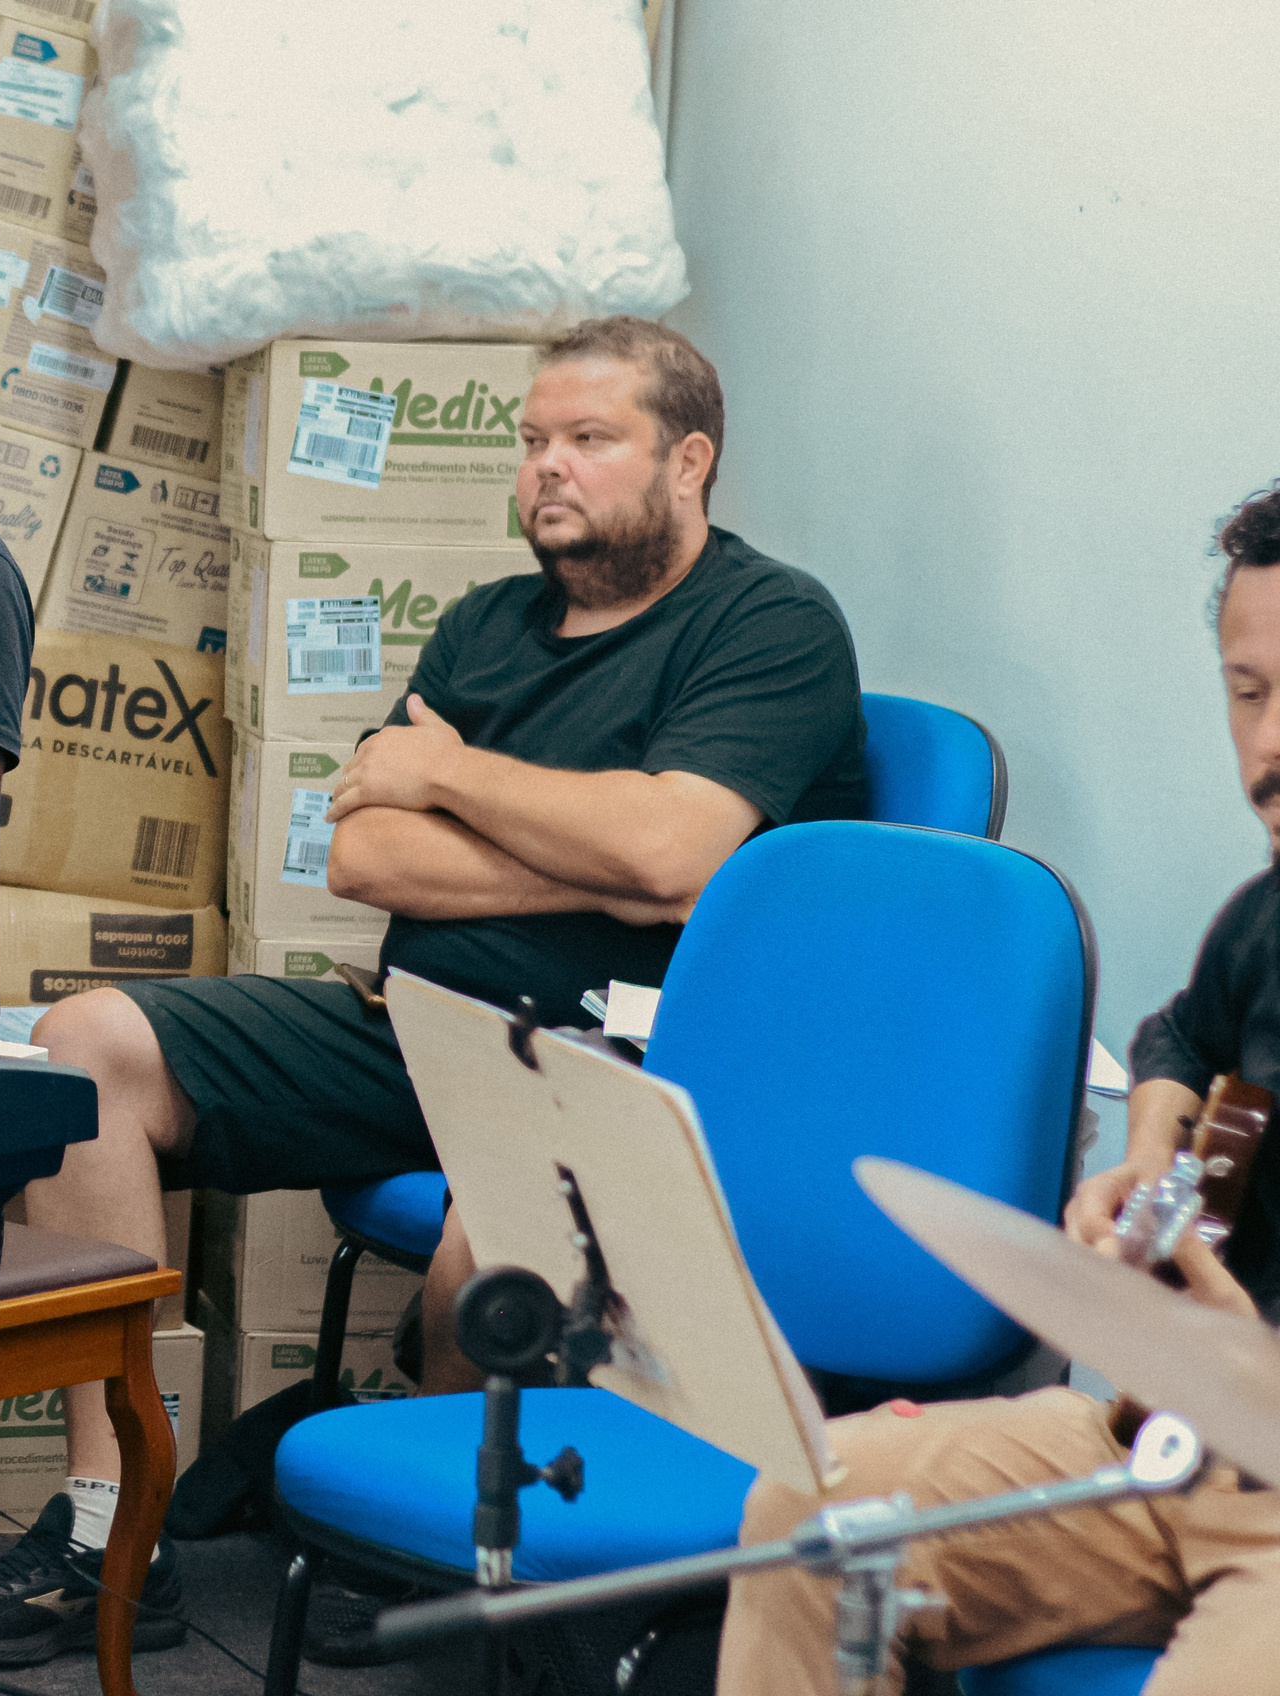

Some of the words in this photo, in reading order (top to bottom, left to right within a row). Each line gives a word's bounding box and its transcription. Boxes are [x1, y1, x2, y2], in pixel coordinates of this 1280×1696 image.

[157, 546, 186, 582] Top
[52, 739, 194, 776] DESCARTÁVEL
[95, 930, 153, 944] unidades
[156, 933, 188, 945] 2000
[118, 947, 166, 960] Contém
